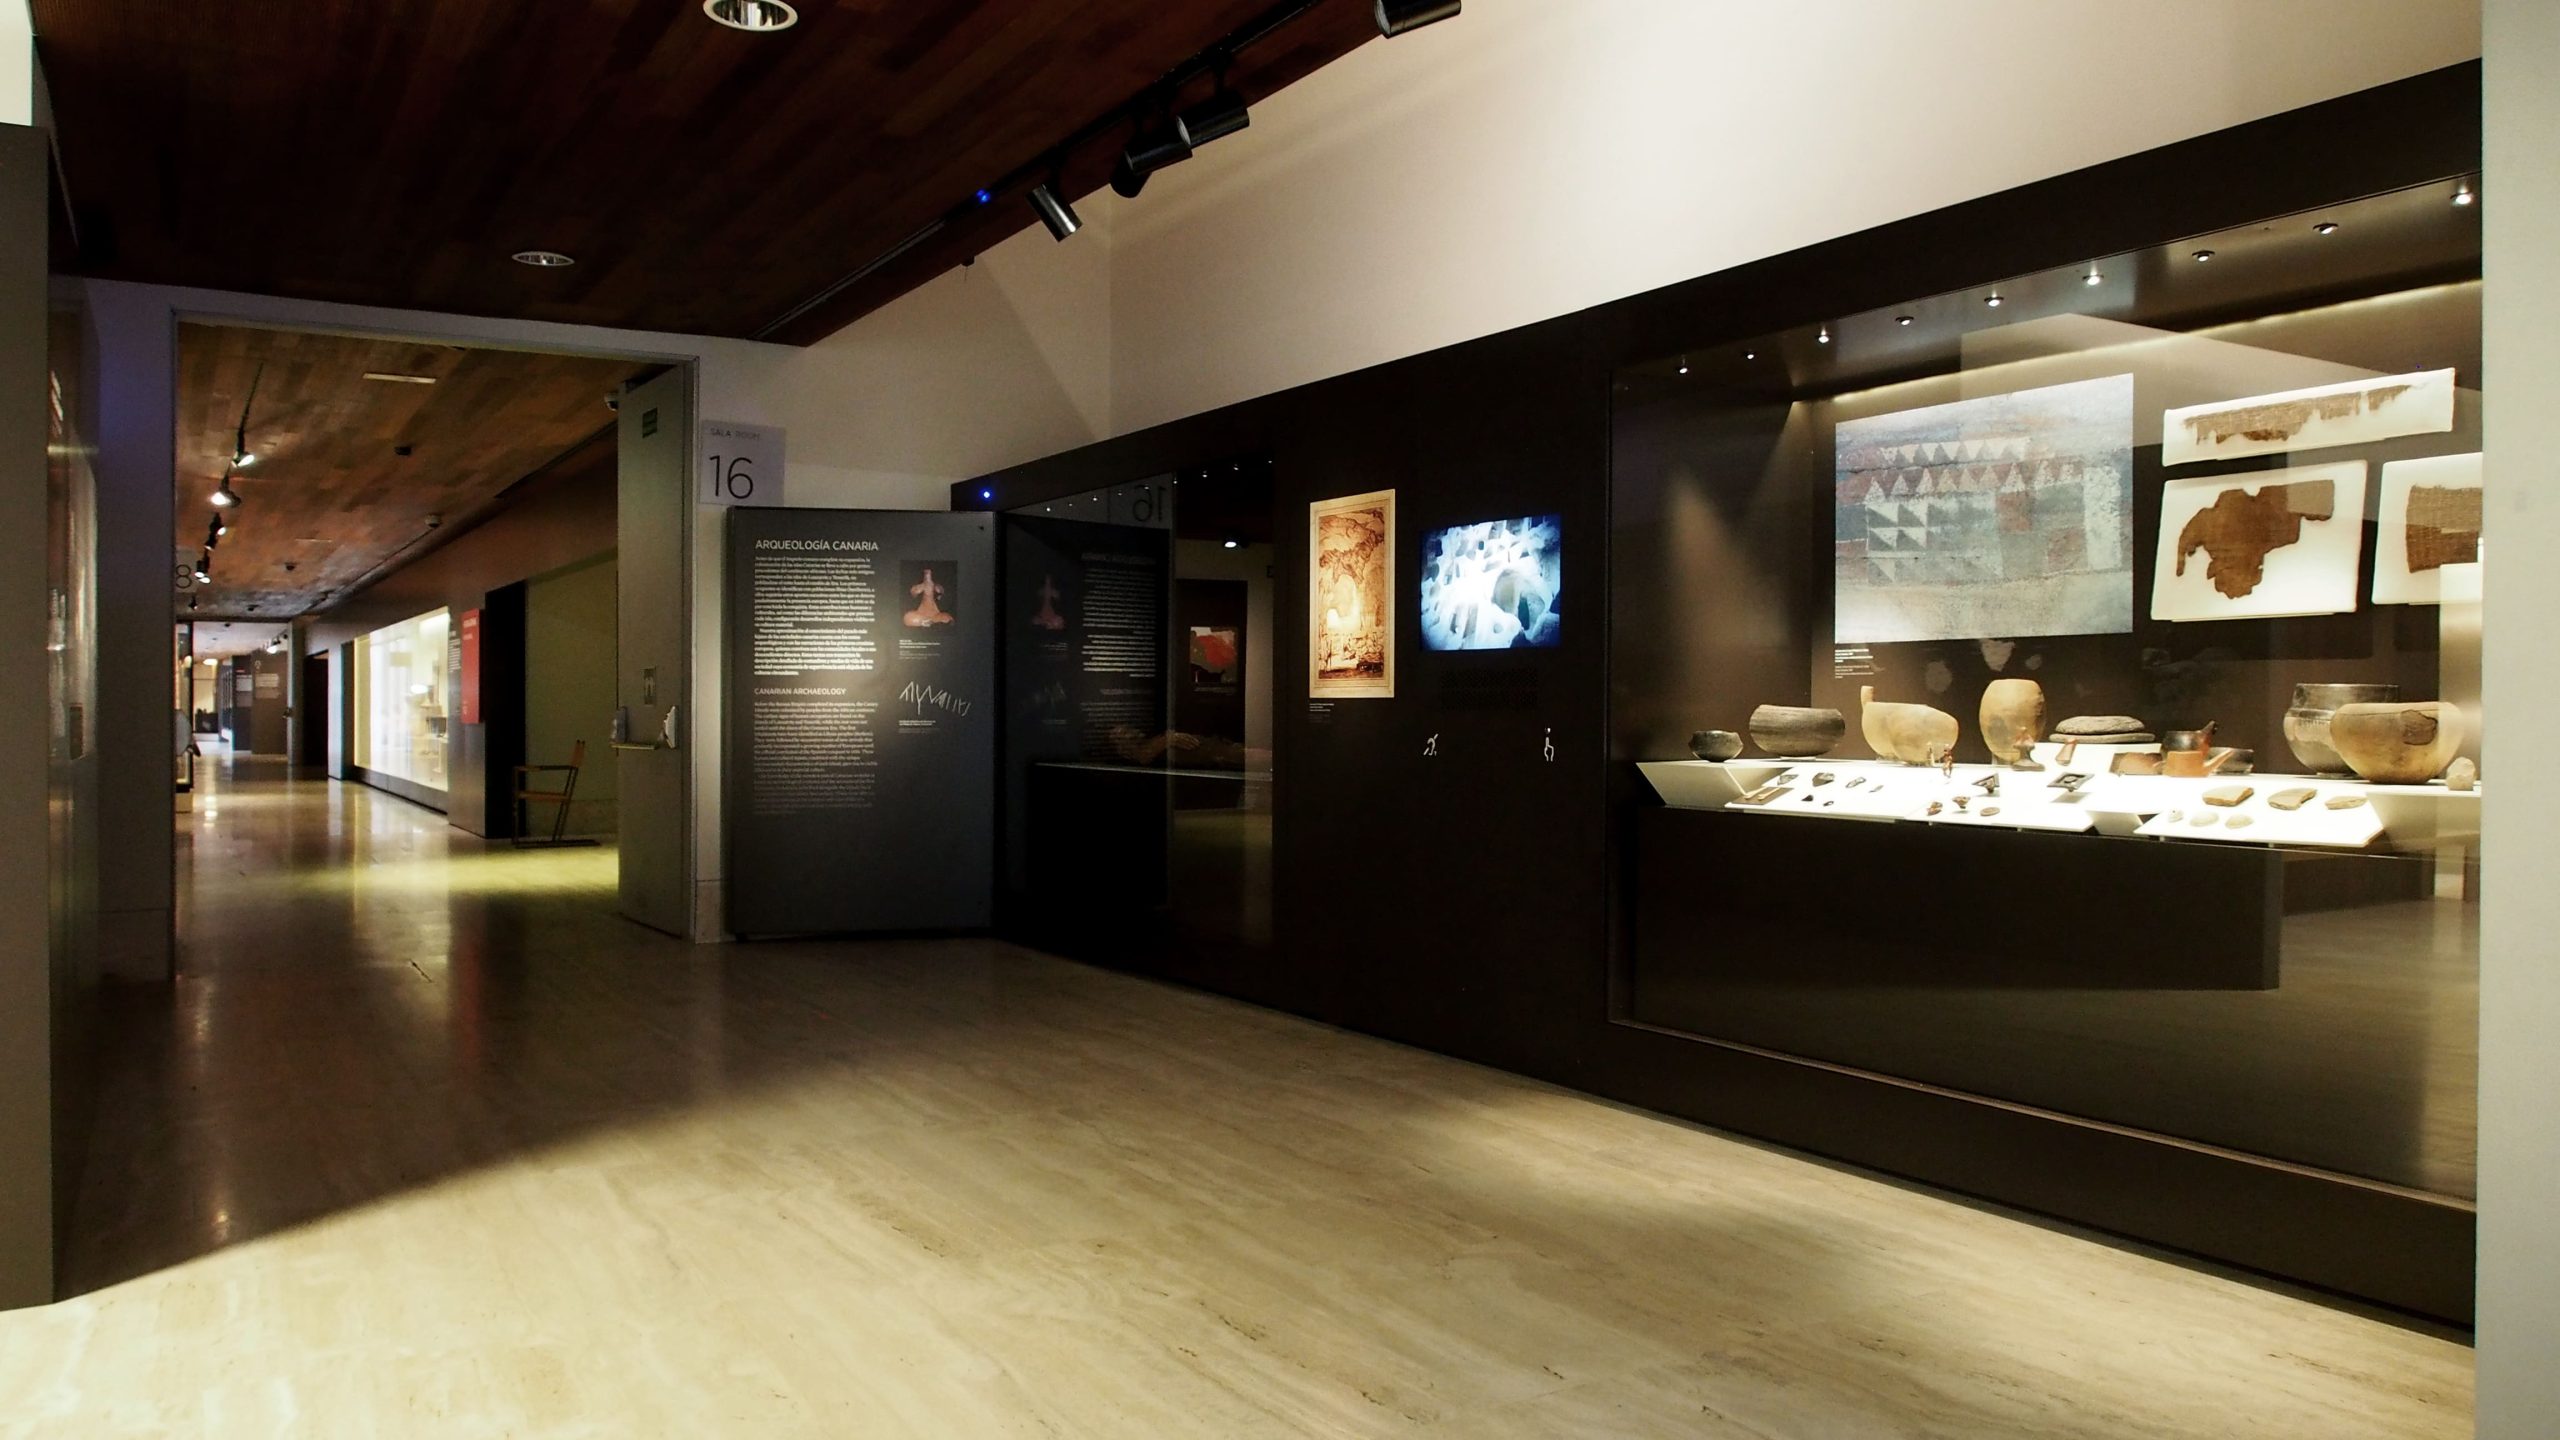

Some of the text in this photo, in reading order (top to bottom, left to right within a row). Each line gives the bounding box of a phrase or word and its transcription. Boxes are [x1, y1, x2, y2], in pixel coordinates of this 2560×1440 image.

[709, 455, 754, 499] 16
[755, 539, 879, 551] ARQUEOLOGÍA CANARIA
[753, 687, 847, 696] CANARIAN ARCHAEOLOGY
